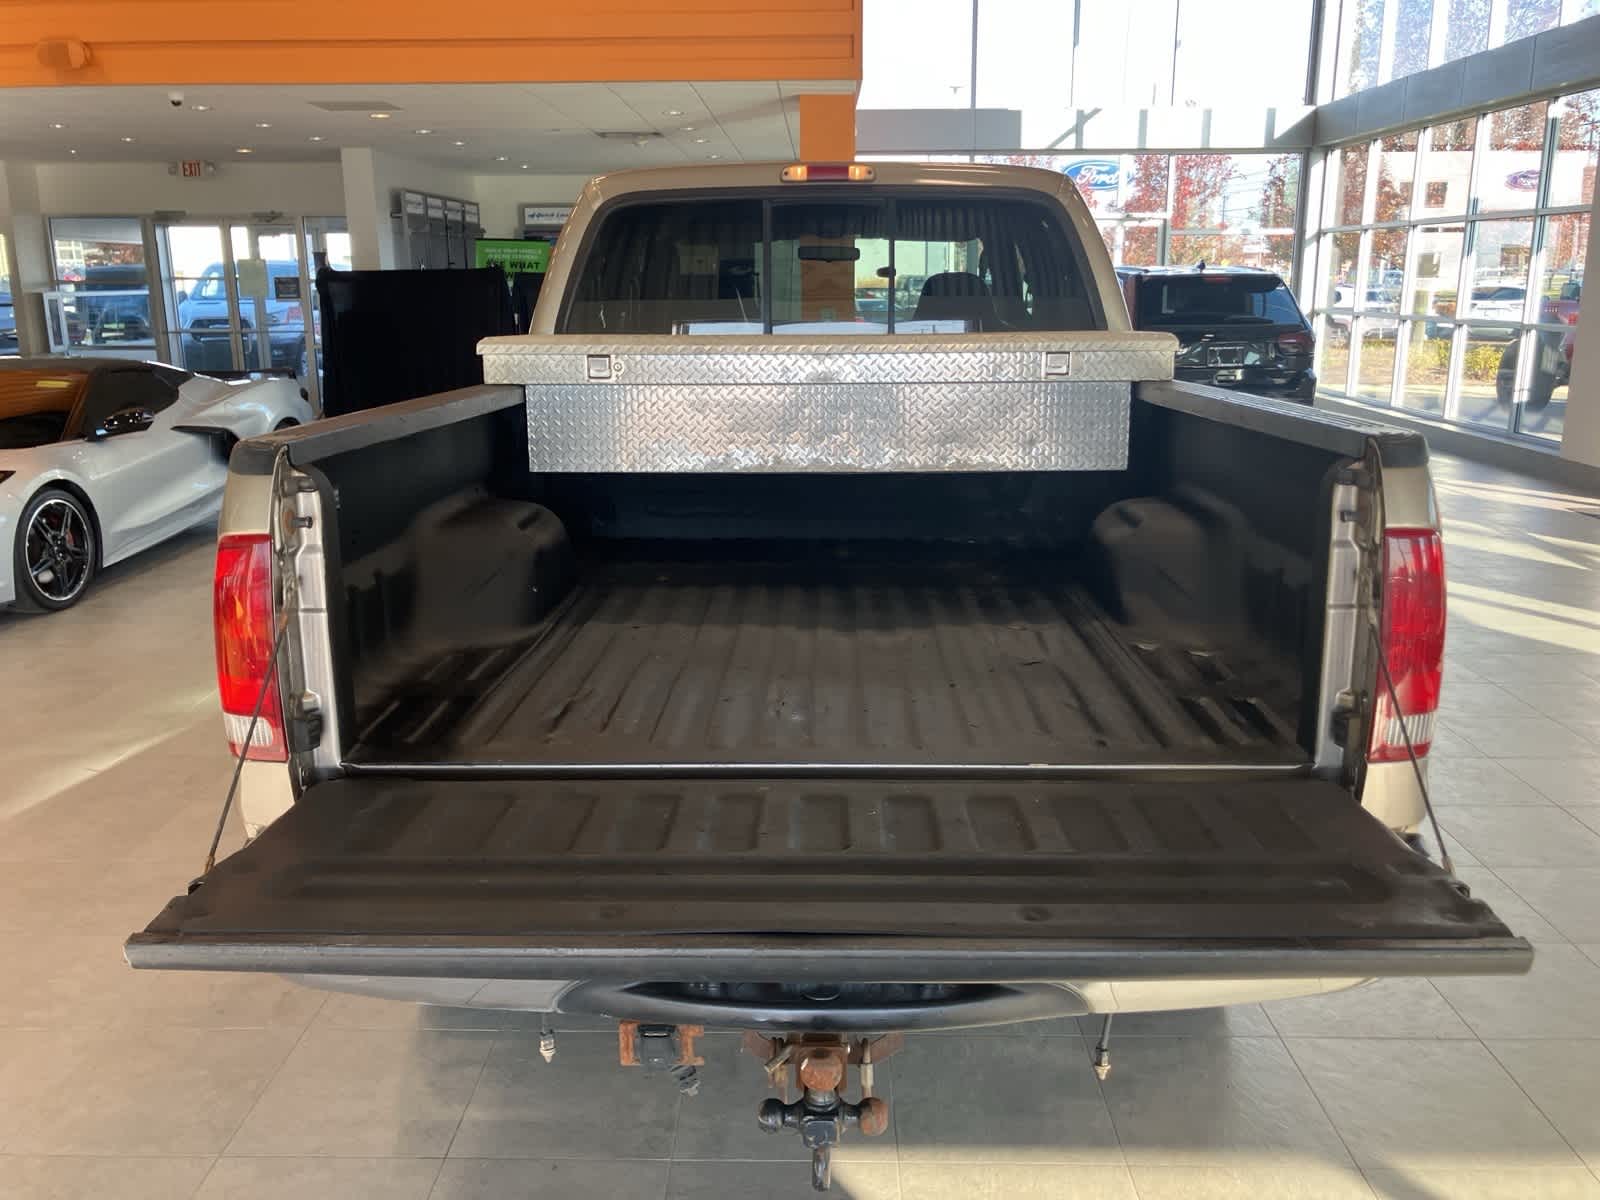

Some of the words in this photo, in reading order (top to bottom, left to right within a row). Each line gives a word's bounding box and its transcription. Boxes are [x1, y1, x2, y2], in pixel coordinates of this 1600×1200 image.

[183, 161, 200, 176] EXIT
[1076, 166, 1120, 184] Ford
[510, 261, 541, 270] WHAT
